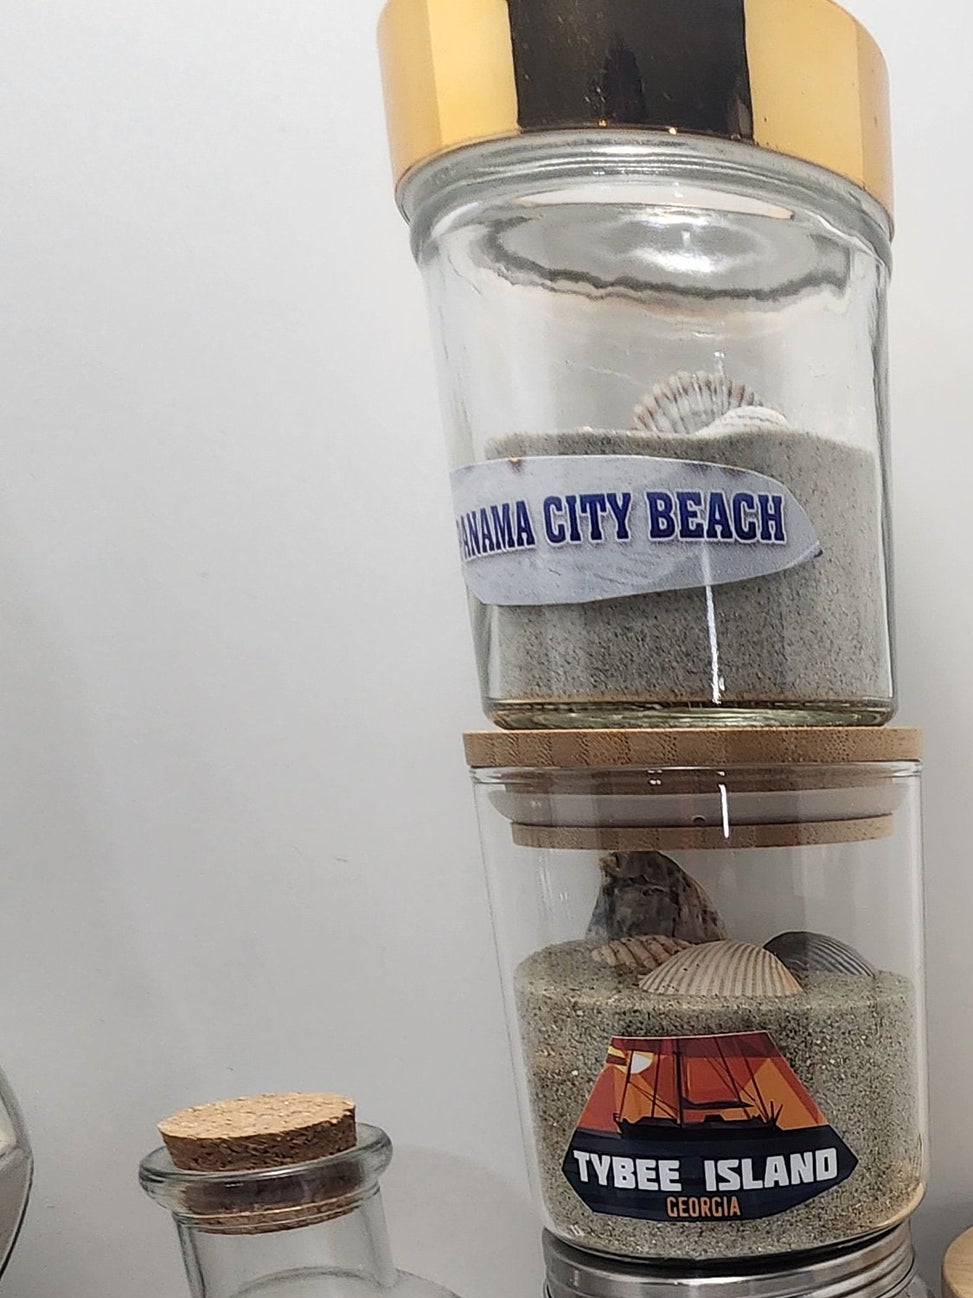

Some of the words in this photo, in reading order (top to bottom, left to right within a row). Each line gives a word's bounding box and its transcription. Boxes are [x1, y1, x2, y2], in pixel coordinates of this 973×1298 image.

[456, 500, 536, 560] ANAMA
[543, 492, 631, 544] CITY
[648, 491, 786, 543] BEACH
[573, 1149, 682, 1192] TYBEE
[704, 1147, 838, 1192] ISLAND
[666, 1196, 741, 1218] GEORGIA
